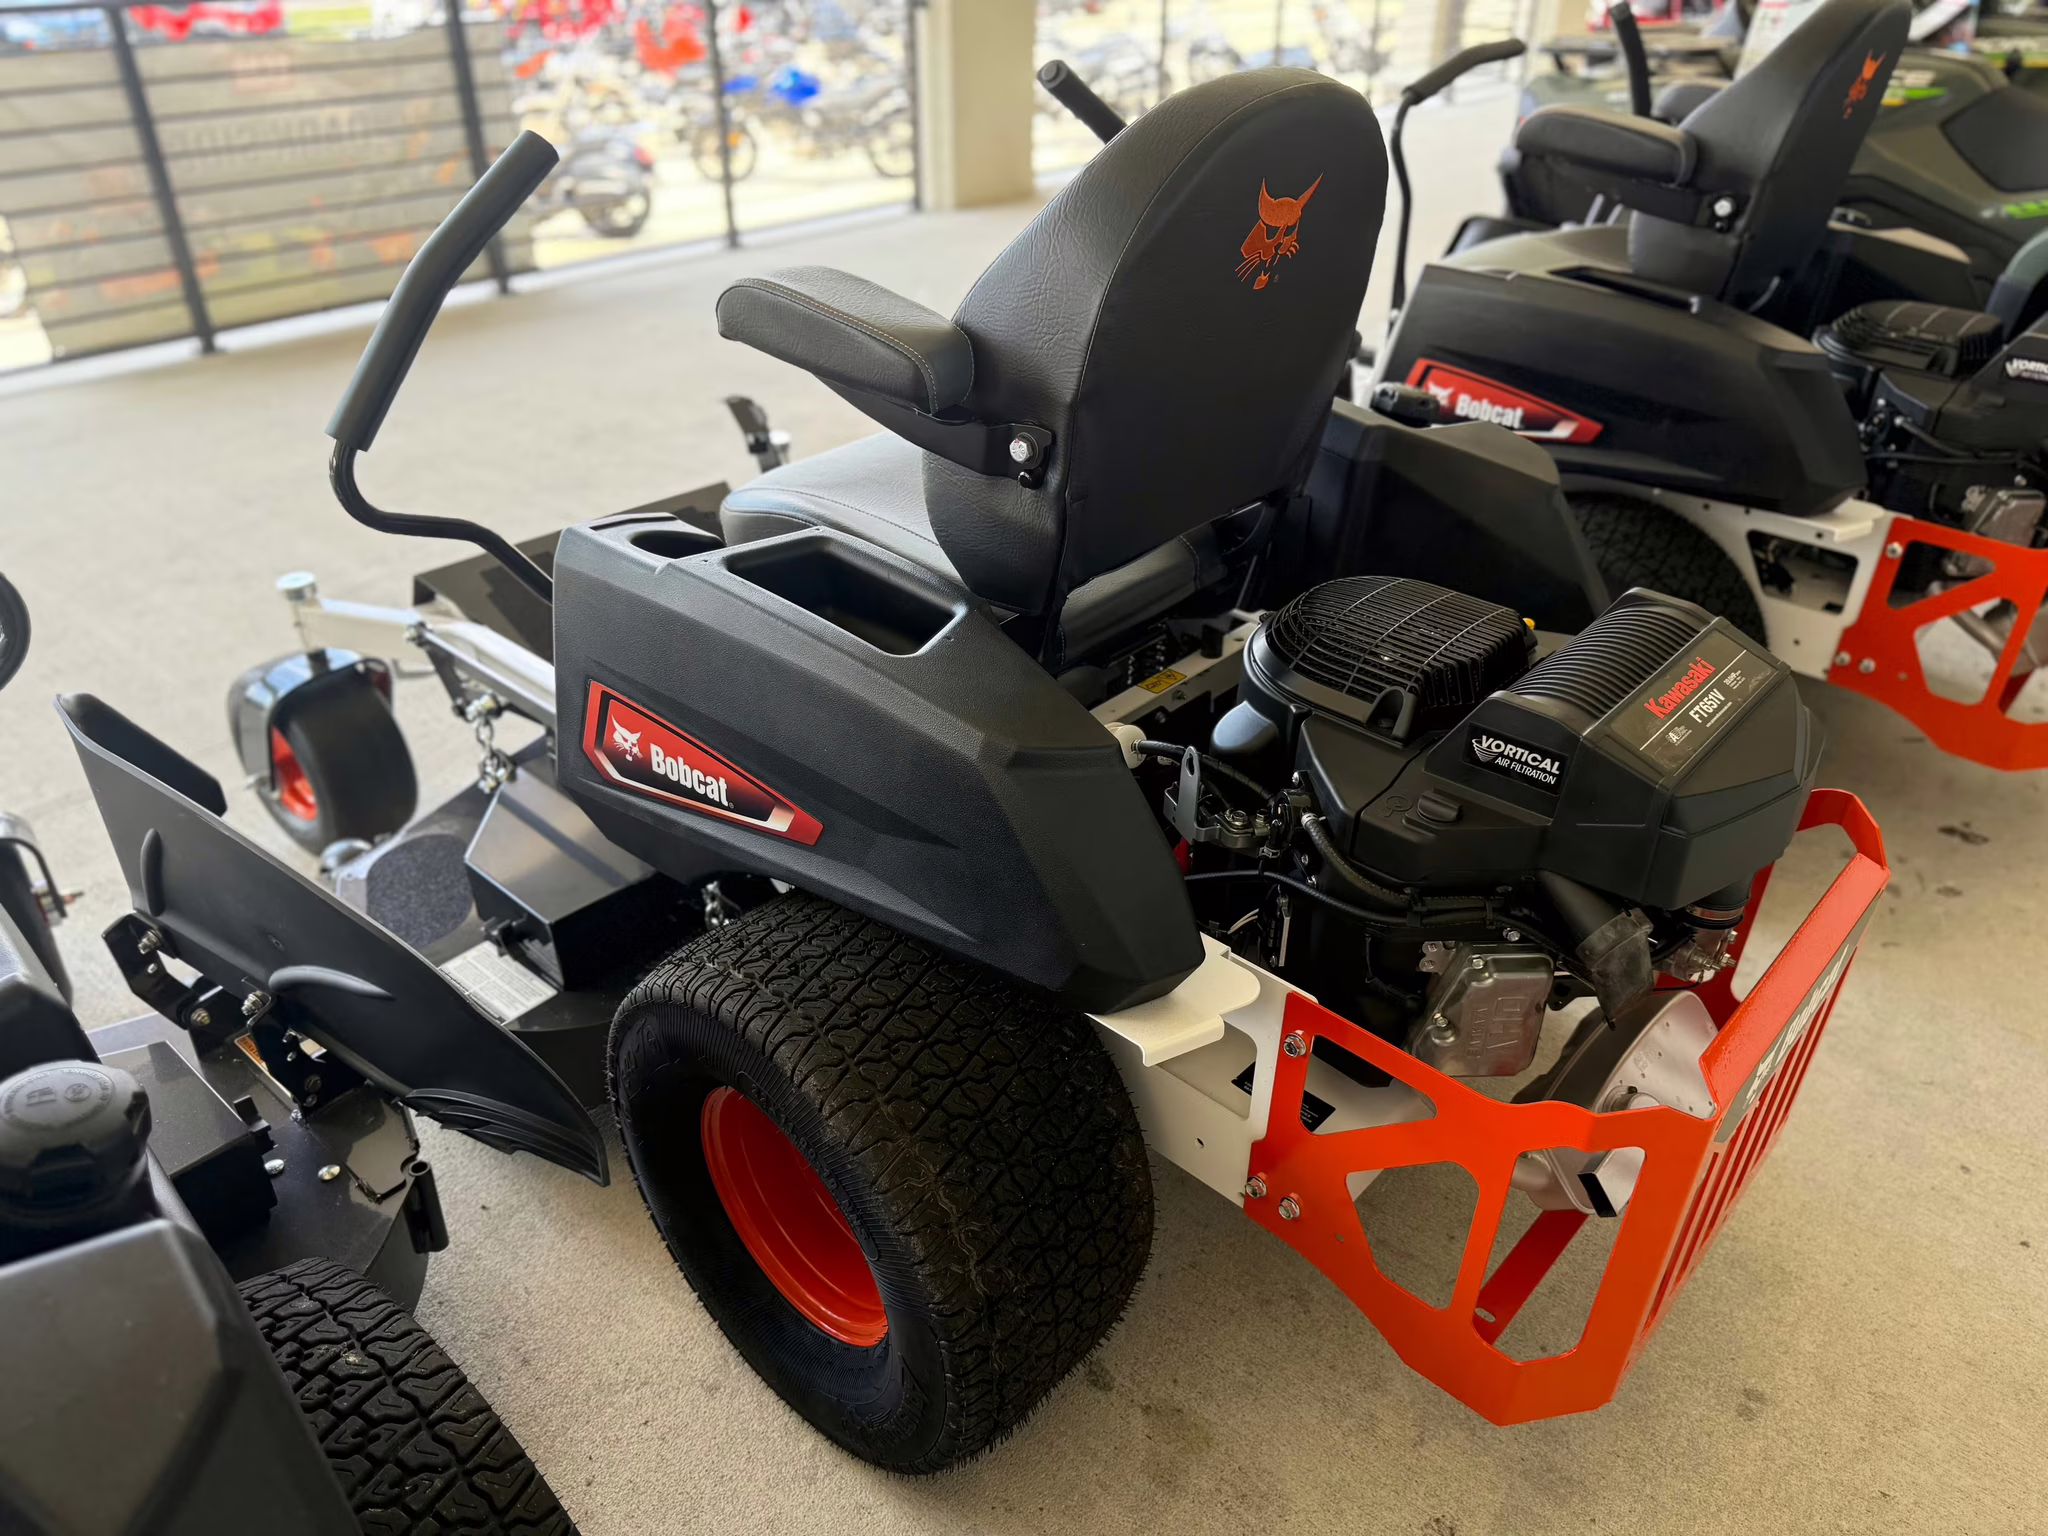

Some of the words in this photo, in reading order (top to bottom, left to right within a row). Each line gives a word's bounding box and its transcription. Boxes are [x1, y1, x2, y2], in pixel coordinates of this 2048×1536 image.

[1455, 393, 1524, 429] Bobcat
[1644, 657, 1716, 720] Kawasaki
[1689, 688, 1725, 723] FT651V
[1482, 735, 1560, 774] VORTICAL
[1495, 757, 1510, 768] AIR
[1510, 762, 1556, 784] FILTRATION
[650, 743, 729, 806] Bobcat
